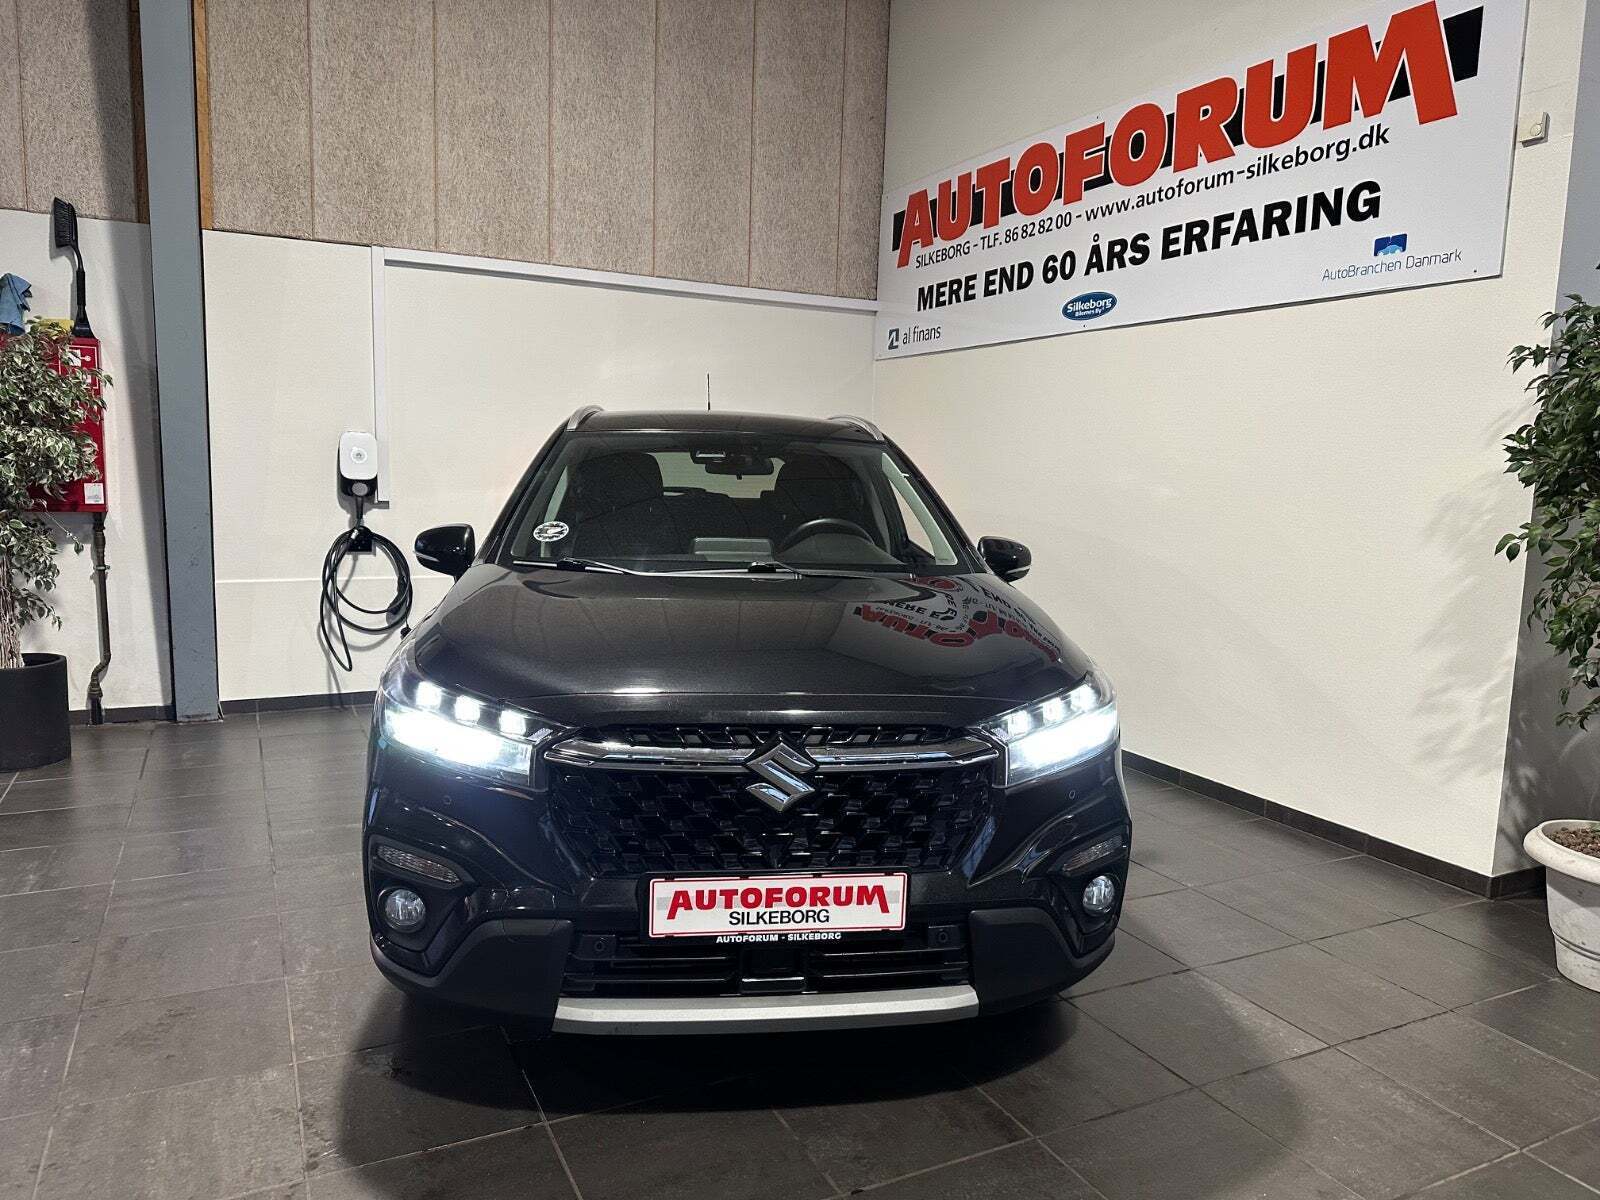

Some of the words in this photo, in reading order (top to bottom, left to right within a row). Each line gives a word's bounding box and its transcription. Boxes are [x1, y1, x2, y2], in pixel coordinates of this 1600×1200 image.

[897, 0, 1458, 269] AUTOFORUM
[915, 240, 971, 269] SILKEBORG
[980, 233, 1002, 252] TLF.
[1084, 122, 1390, 222] www.autoforum-silkeborg.dk
[917, 273, 978, 312] MERE
[983, 260, 1035, 298] END
[1042, 250, 1076, 284] 60
[1083, 232, 1151, 277] ÅRS
[1160, 180, 1381, 261] ERFARING
[1322, 259, 1402, 282] AutoBranchen
[1405, 248, 1462, 269] Danmark
[1067, 297, 1113, 313] Silkeborg
[902, 327, 911, 345] al
[913, 325, 942, 343] finans
[666, 885, 890, 920] AUTOFORUM
[728, 908, 830, 926] SILKEBORG
[716, 933, 779, 944] AUTOFORUM
[787, 932, 842, 941] SILKEBORG
